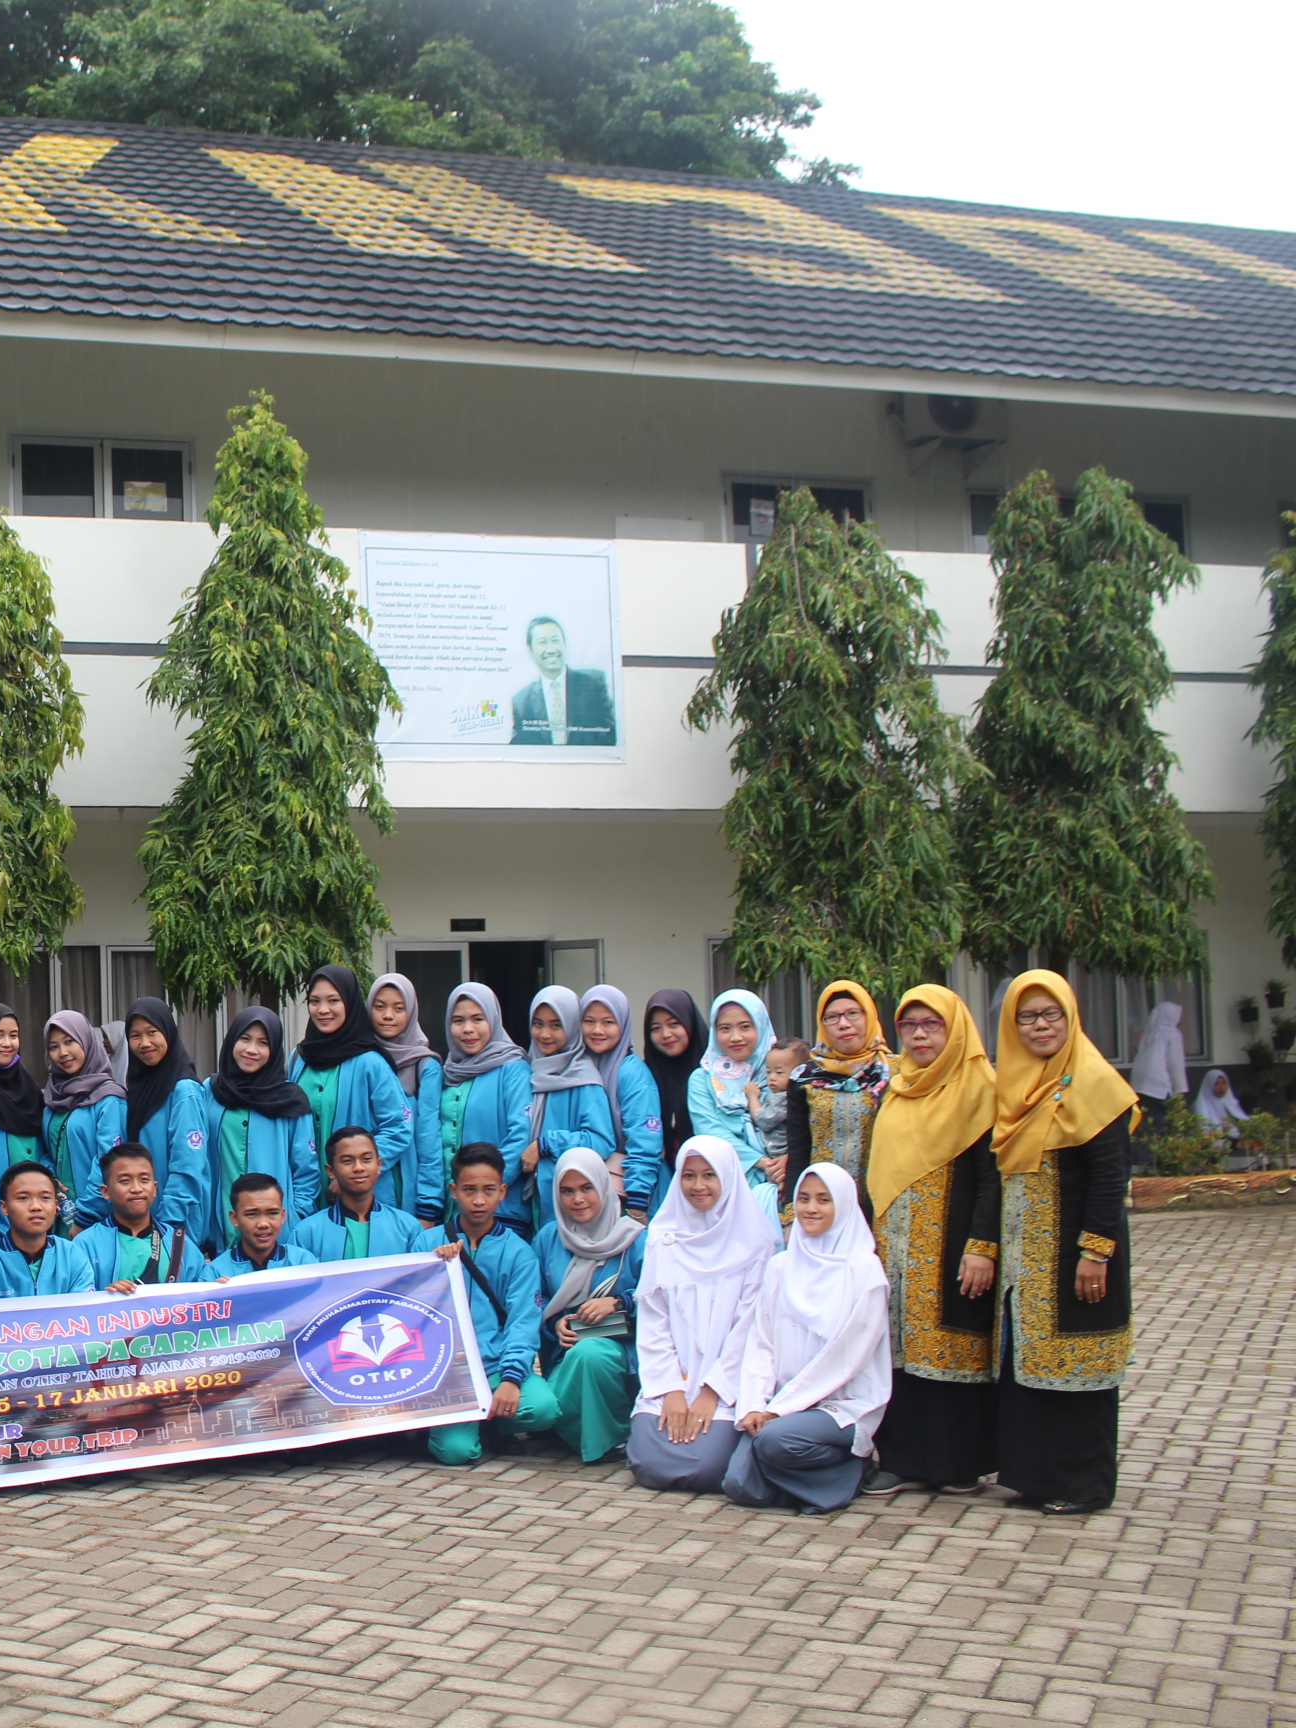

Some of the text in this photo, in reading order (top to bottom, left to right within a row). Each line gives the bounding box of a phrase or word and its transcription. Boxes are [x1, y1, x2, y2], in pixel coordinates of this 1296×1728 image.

[450, 704, 480, 723] SMK
[99, 1300, 232, 1333] INDUSTRI
[302, 1298, 441, 1342] SMK MUHAMMADIYAH PAGARALAM
[84, 1320, 286, 1365] PAGARALAM
[20, 1373, 70, 1389] OTKP
[73, 1366, 137, 1383] TAHUN
[139, 1356, 206, 1375] AJARAN
[210, 1348, 280, 1367] 2019-2020
[305, 1362, 344, 1396] OTOMATISASI
[345, 1392, 362, 1400] DAN
[383, 1385, 415, 1399] KELOLAH
[416, 1344, 446, 1387] PERKANTORAN
[349, 1368, 413, 1386] OTKP
[34, 1391, 63, 1409] 17
[70, 1379, 180, 1405] JANUARI
[184, 1370, 242, 1390] 2020
[15, 1437, 81, 1458] YOUR
[83, 1428, 138, 1450] TRIP
